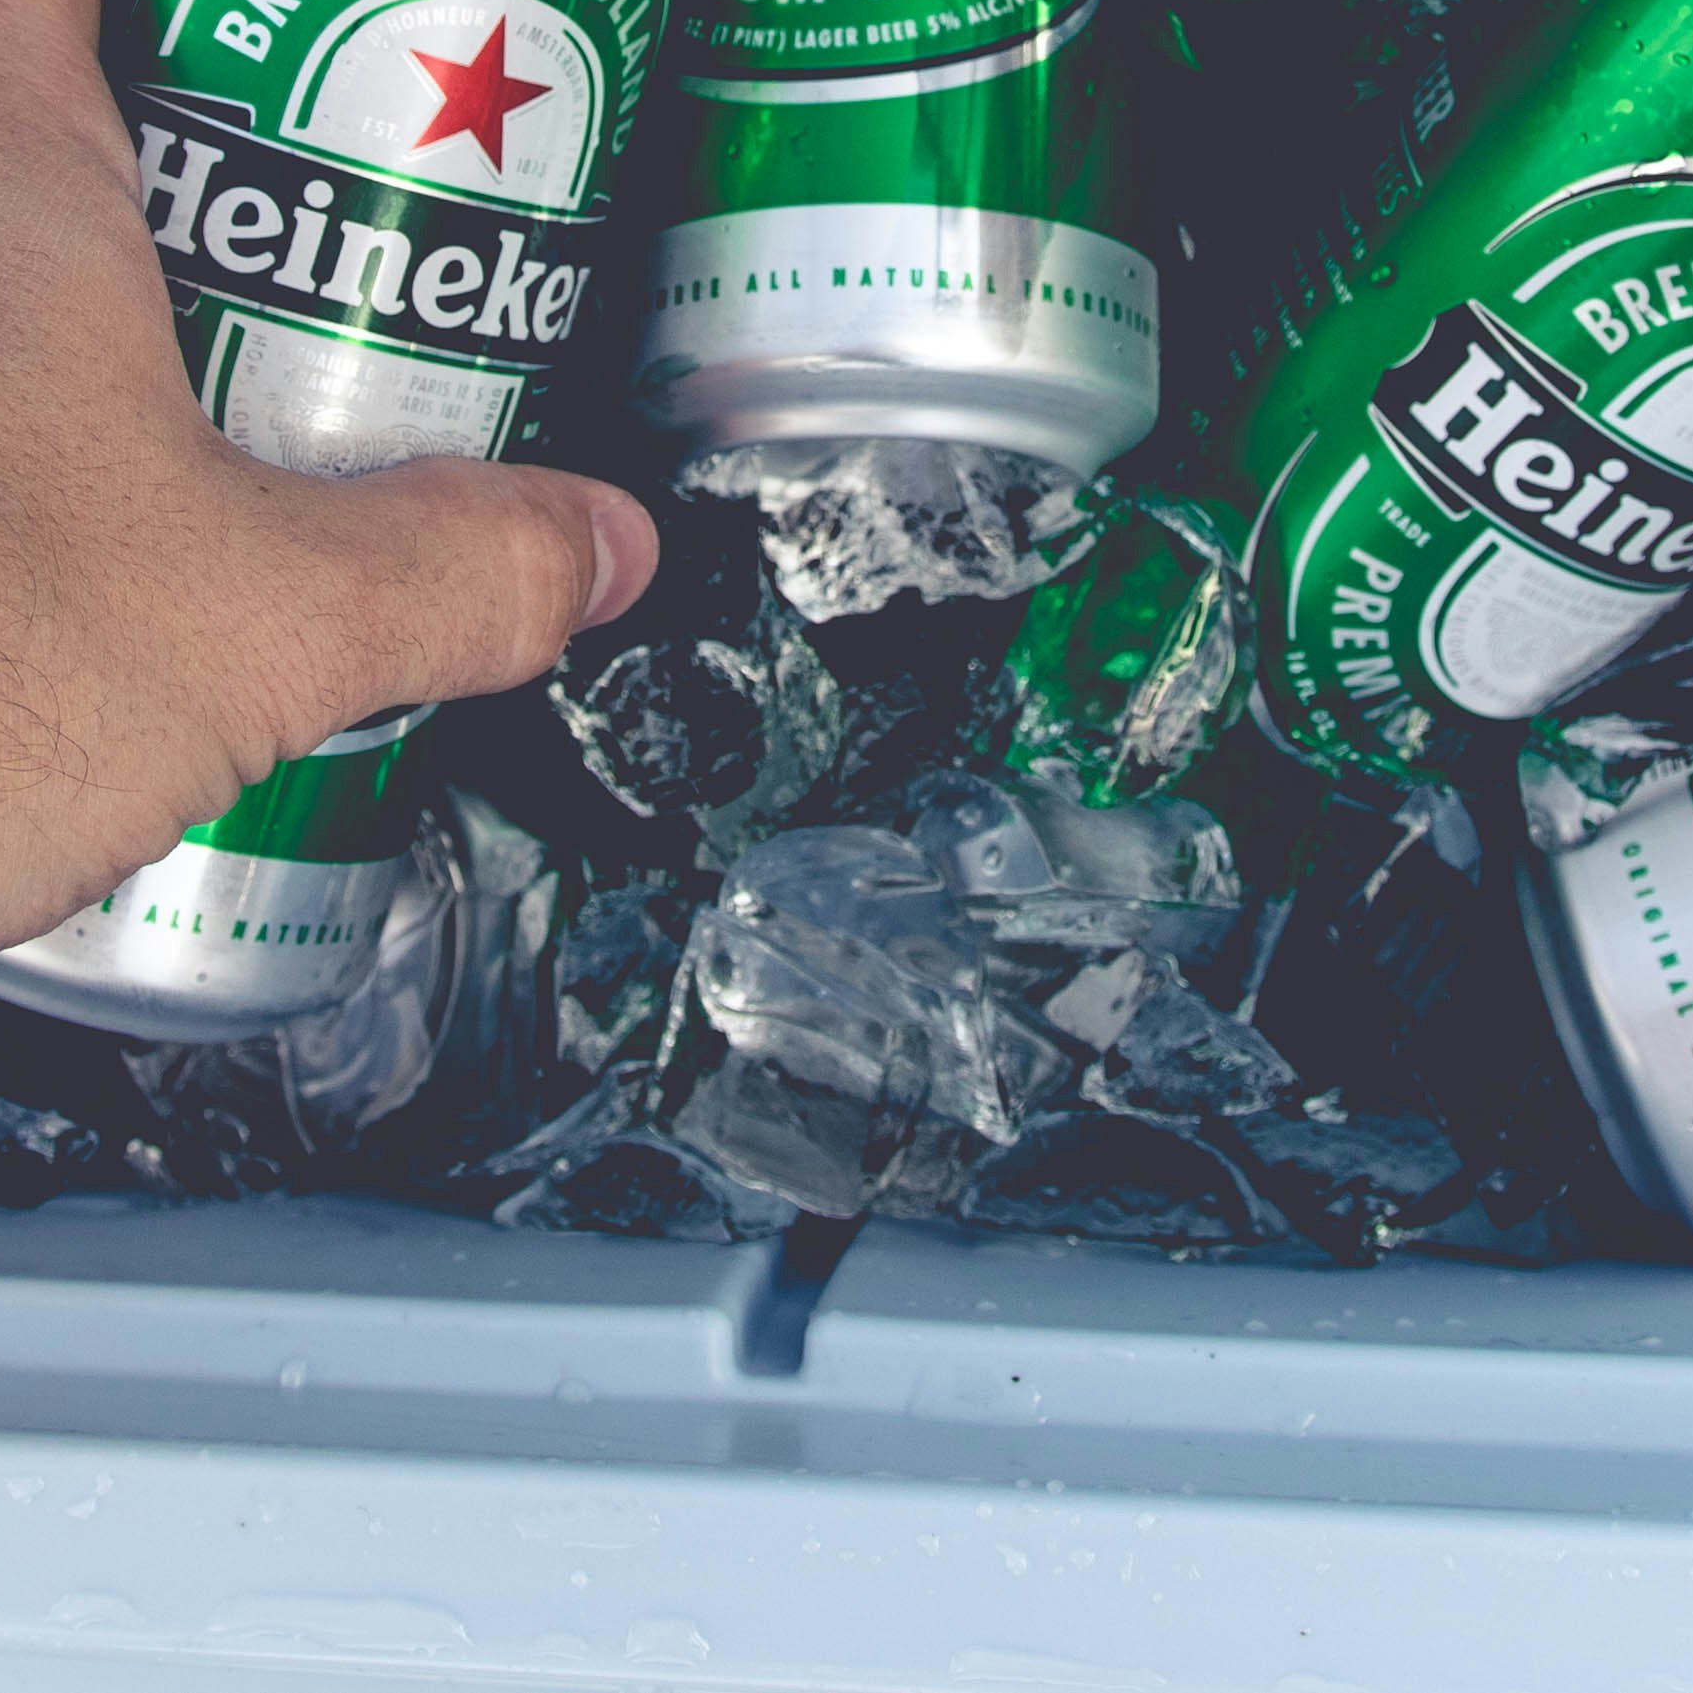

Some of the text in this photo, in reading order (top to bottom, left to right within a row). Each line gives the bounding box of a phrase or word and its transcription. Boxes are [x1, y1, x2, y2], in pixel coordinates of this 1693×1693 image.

[792, 24, 859, 51] LAGER
[865, 18, 918, 45] BEER
[925, 10, 962, 38] 5%
[744, 268, 802, 294] ALL
[832, 266, 997, 296] NATURAL
[1376, 496, 1435, 550] TRADE
[143, 904, 355, 947] ALL NATURAL
